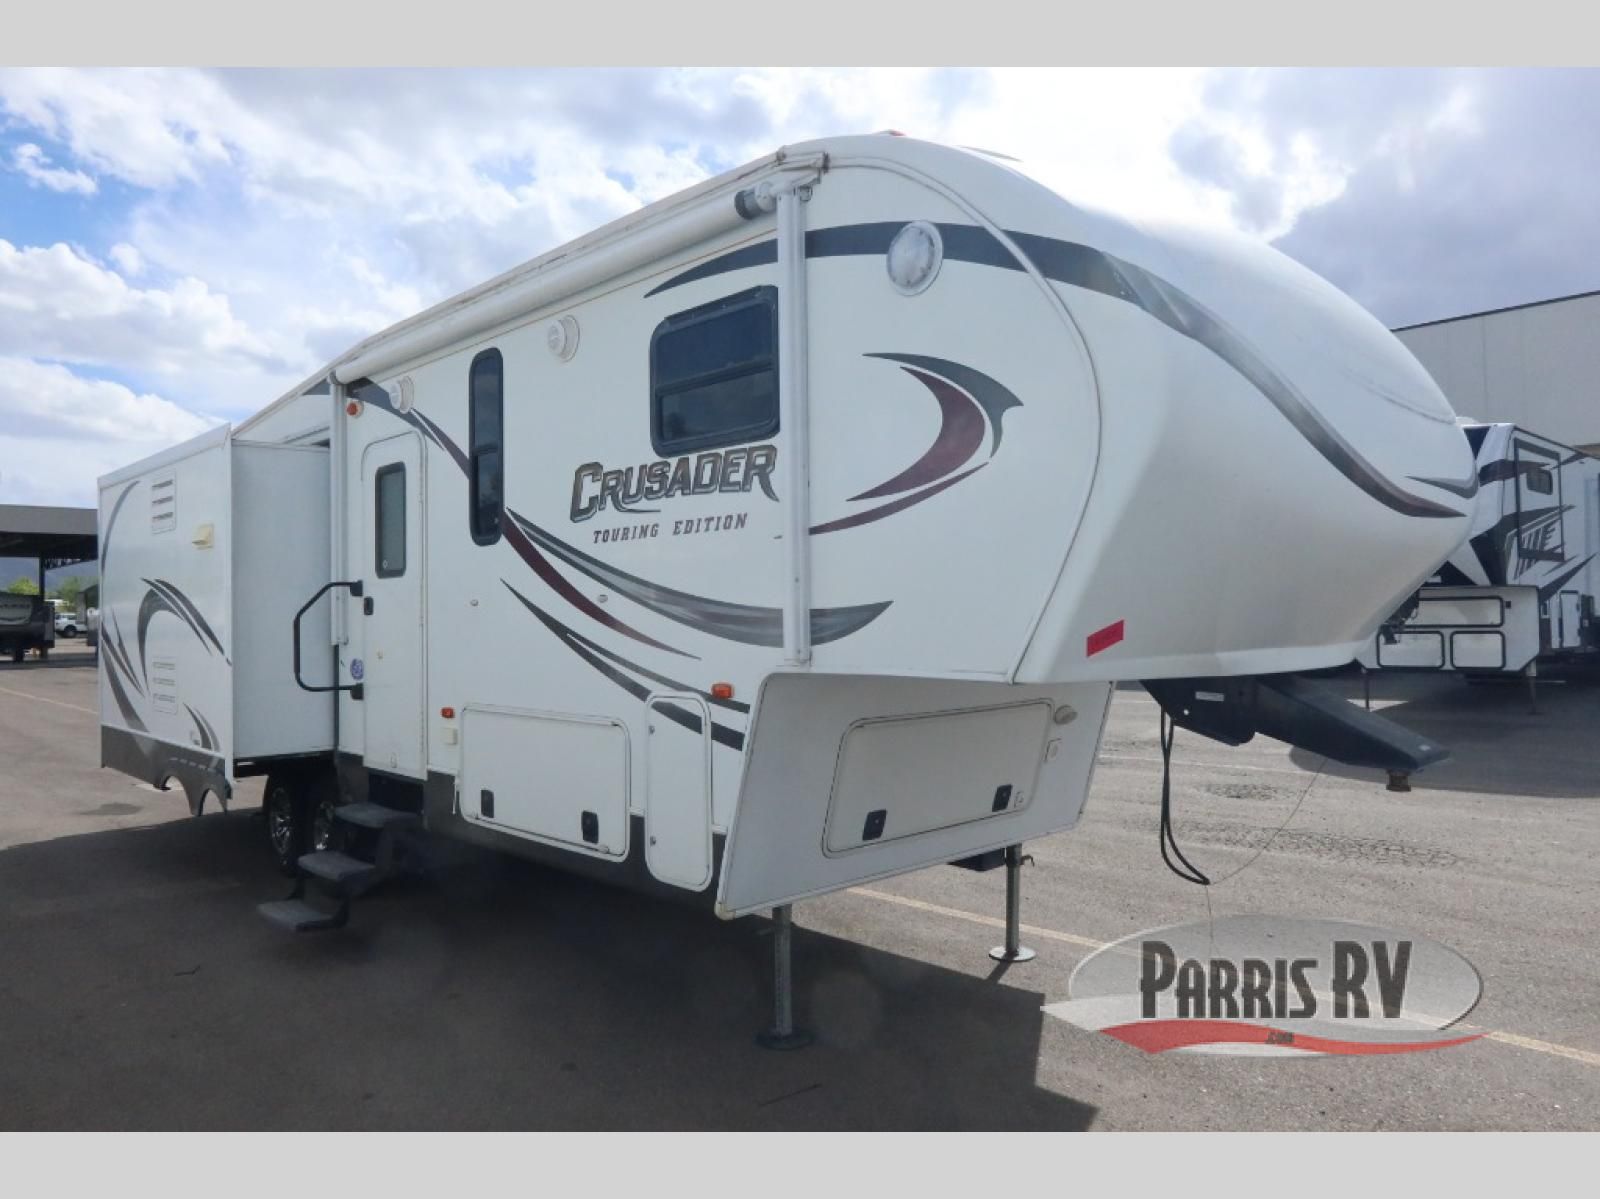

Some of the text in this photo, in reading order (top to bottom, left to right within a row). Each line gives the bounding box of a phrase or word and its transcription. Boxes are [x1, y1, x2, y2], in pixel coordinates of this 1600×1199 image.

[570, 444, 780, 523] CRUSADER
[593, 512, 748, 544] TOURING EDITION
